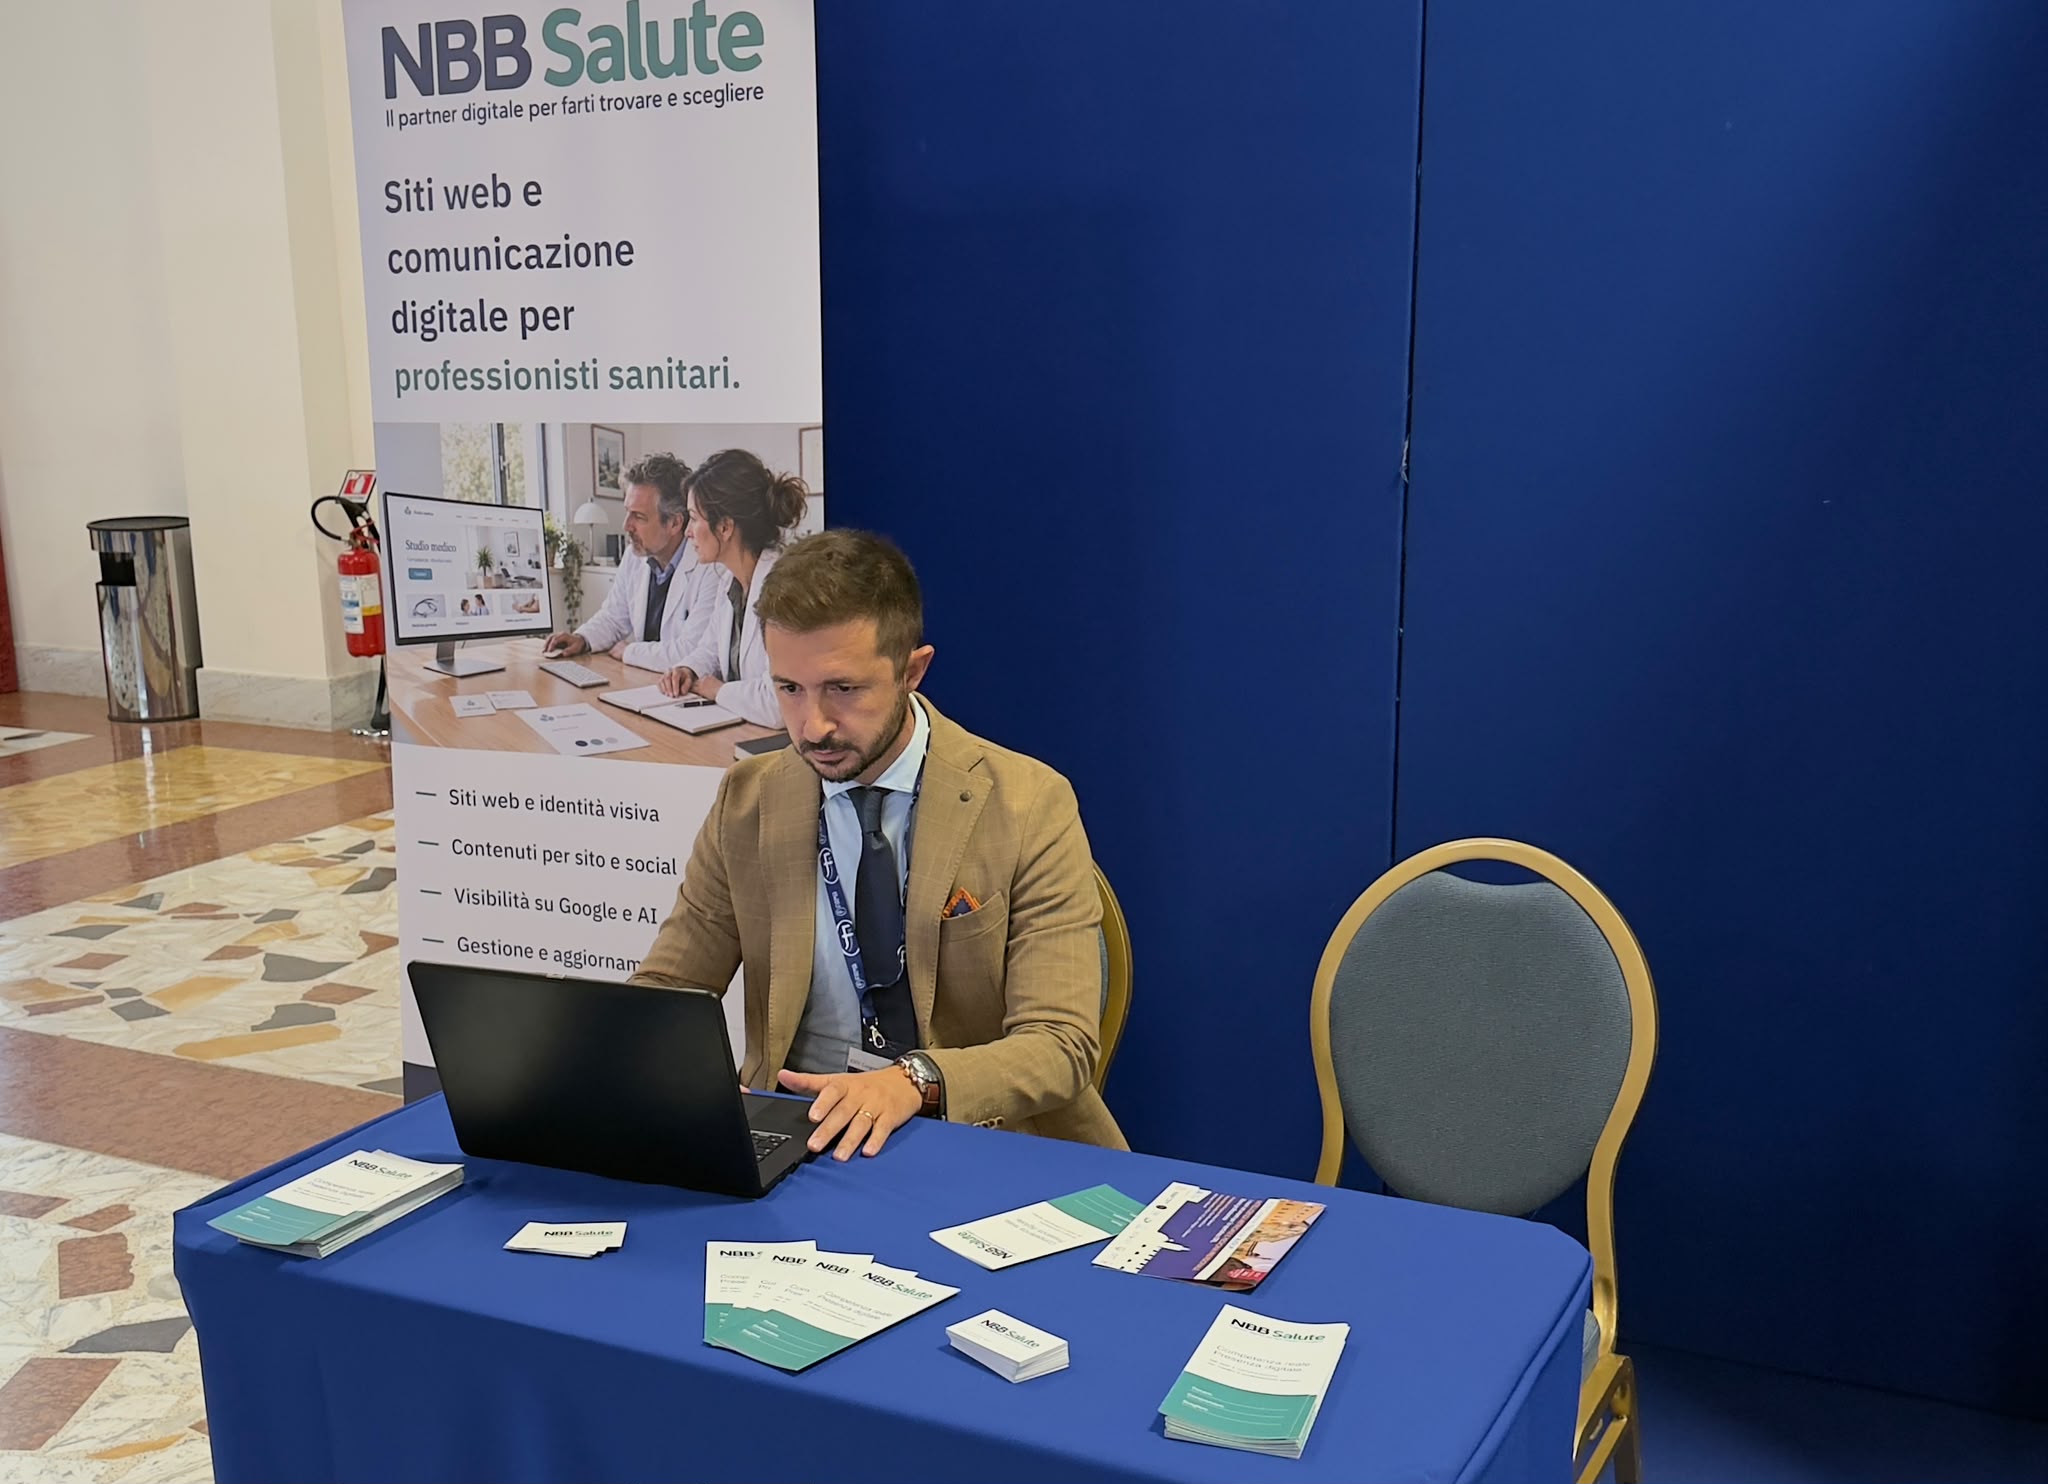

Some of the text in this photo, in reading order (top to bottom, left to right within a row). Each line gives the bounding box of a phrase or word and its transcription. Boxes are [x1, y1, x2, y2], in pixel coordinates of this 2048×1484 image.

[382, 0, 764, 99] NBB Salute
[398, 106, 457, 130] partner
[462, 100, 523, 125] digitale
[529, 102, 557, 121] per
[561, 95, 595, 115] farti
[599, 92, 662, 112] trovare
[667, 92, 678, 107] e
[683, 83, 764, 108] scegliere
[384, 173, 543, 213] Siti web e
[388, 233, 635, 274] comunicazione
[392, 299, 575, 342] digitale per
[395, 356, 740, 398] professionisti sanitari.
[405, 540, 429, 551] Studio
[449, 789, 660, 822] Siti web e identità visiva
[452, 839, 677, 876] Contenuti per sito e social
[454, 888, 657, 924] Visibilità su Google e AI
[457, 937, 534, 959] Gestione
[538, 947, 548, 960] e
[349, 1159, 413, 1178] NBB Salute
[816, 1262, 849, 1274] NBB
[862, 1272, 933, 1299] NBB Salute
[981, 1320, 1040, 1348] NBB Salute
[1231, 1319, 1326, 1341] NBB Salute
